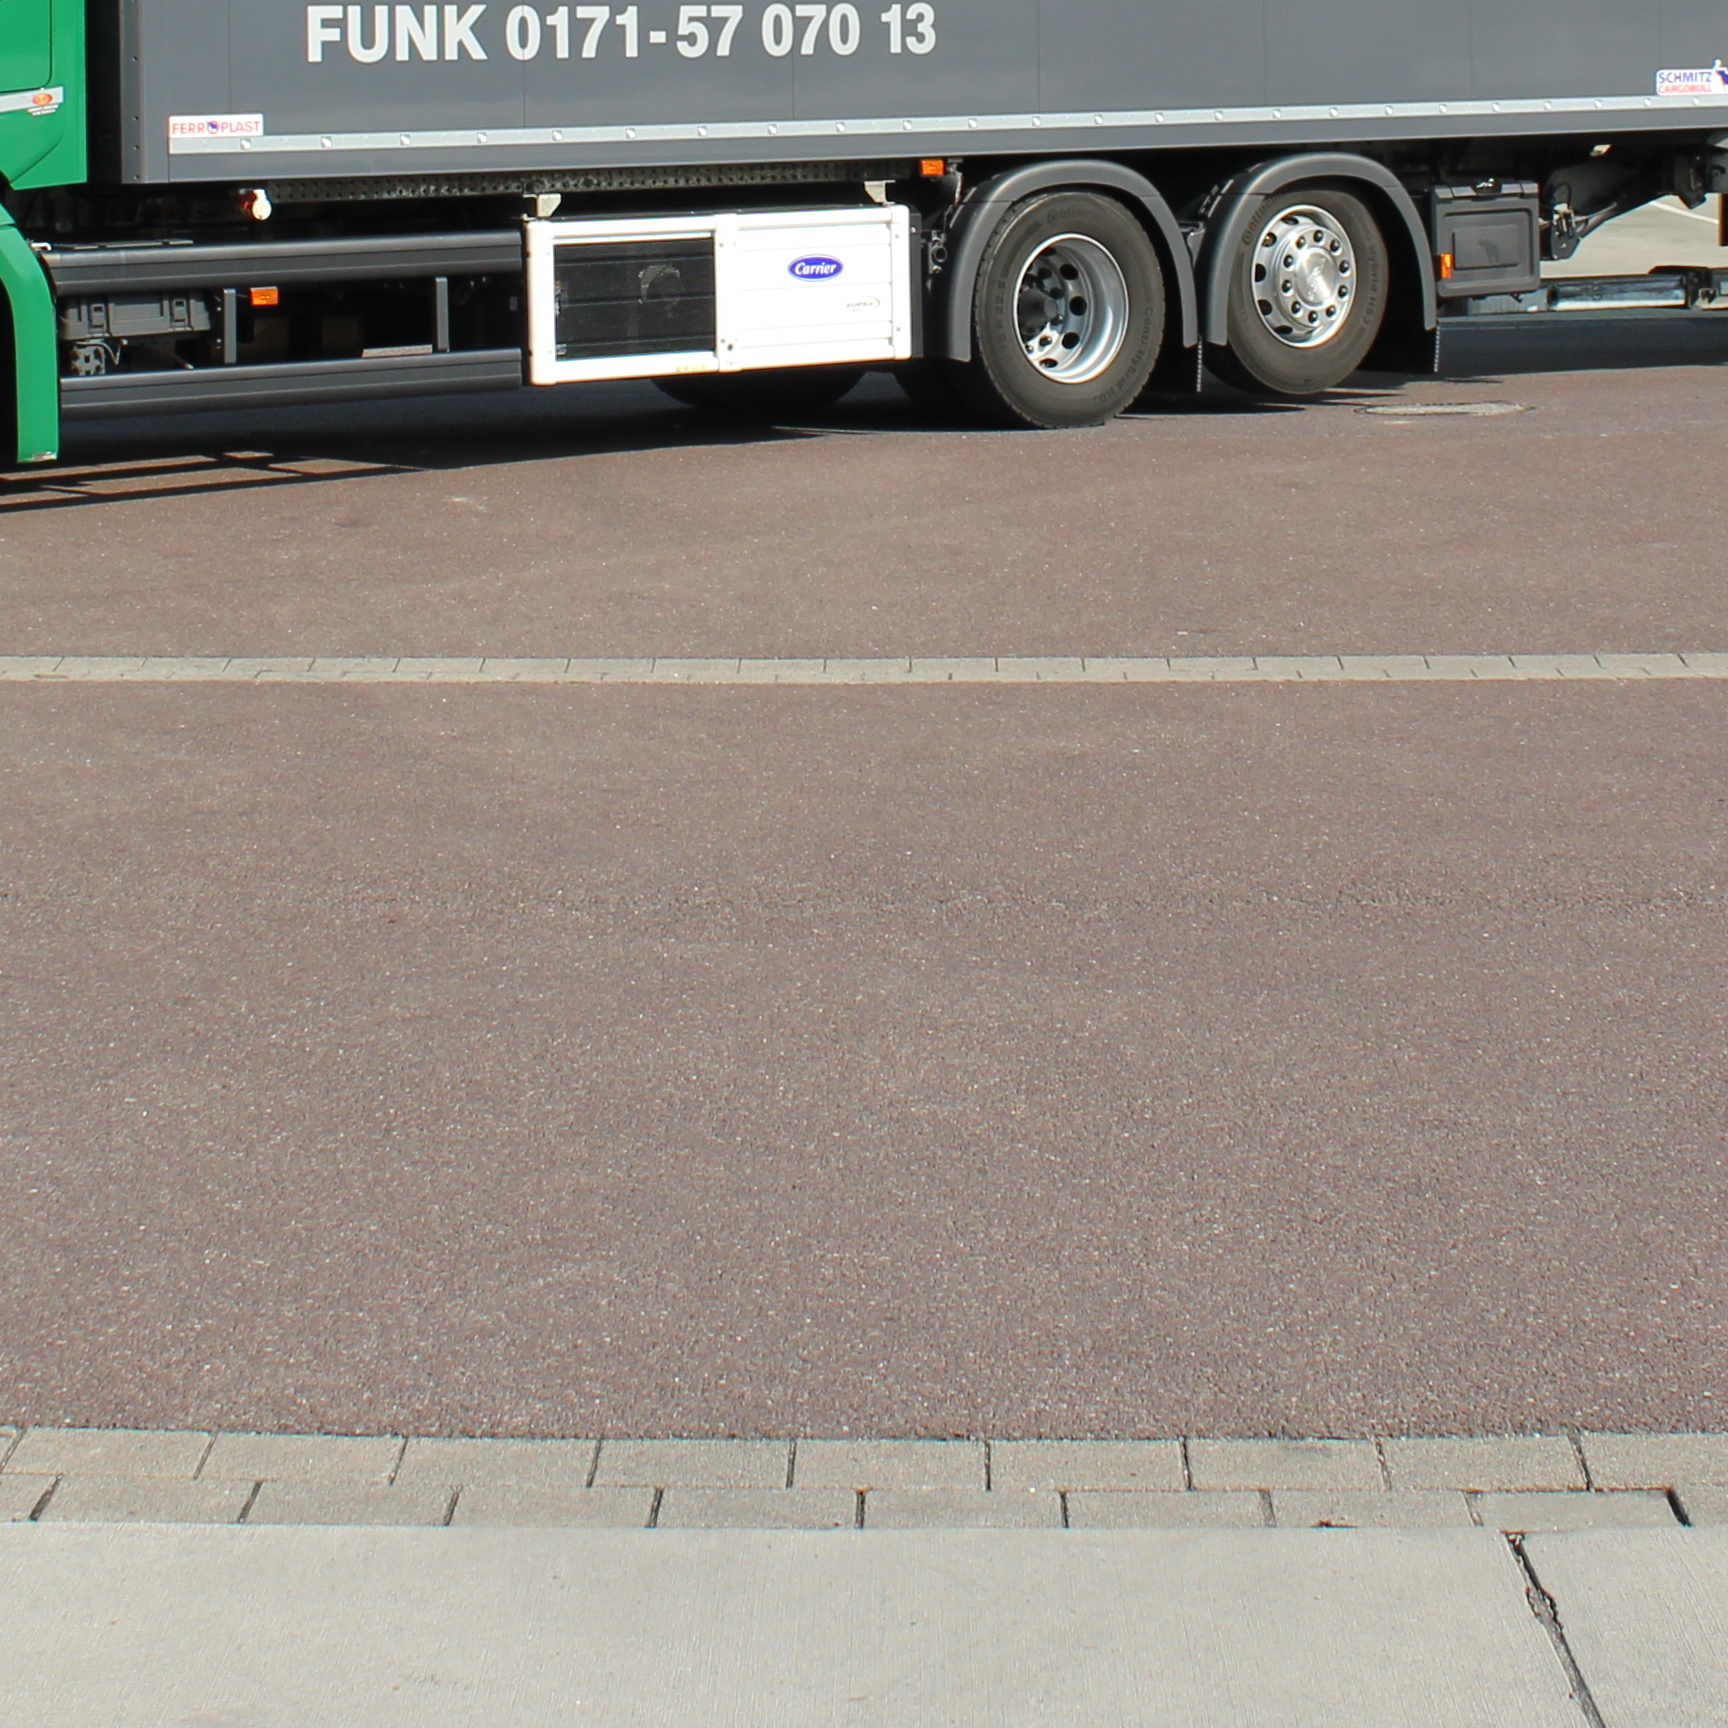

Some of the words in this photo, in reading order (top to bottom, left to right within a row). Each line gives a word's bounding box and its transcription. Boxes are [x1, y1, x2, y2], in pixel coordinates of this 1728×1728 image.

[307, 4, 489, 63] FUNK
[505, 3, 744, 61] 0171-57
[761, 3, 860, 57] 070
[880, 2, 936, 55] 13
[1658, 71, 1712, 83] SCHMITZ
[794, 261, 838, 276] Carrier
